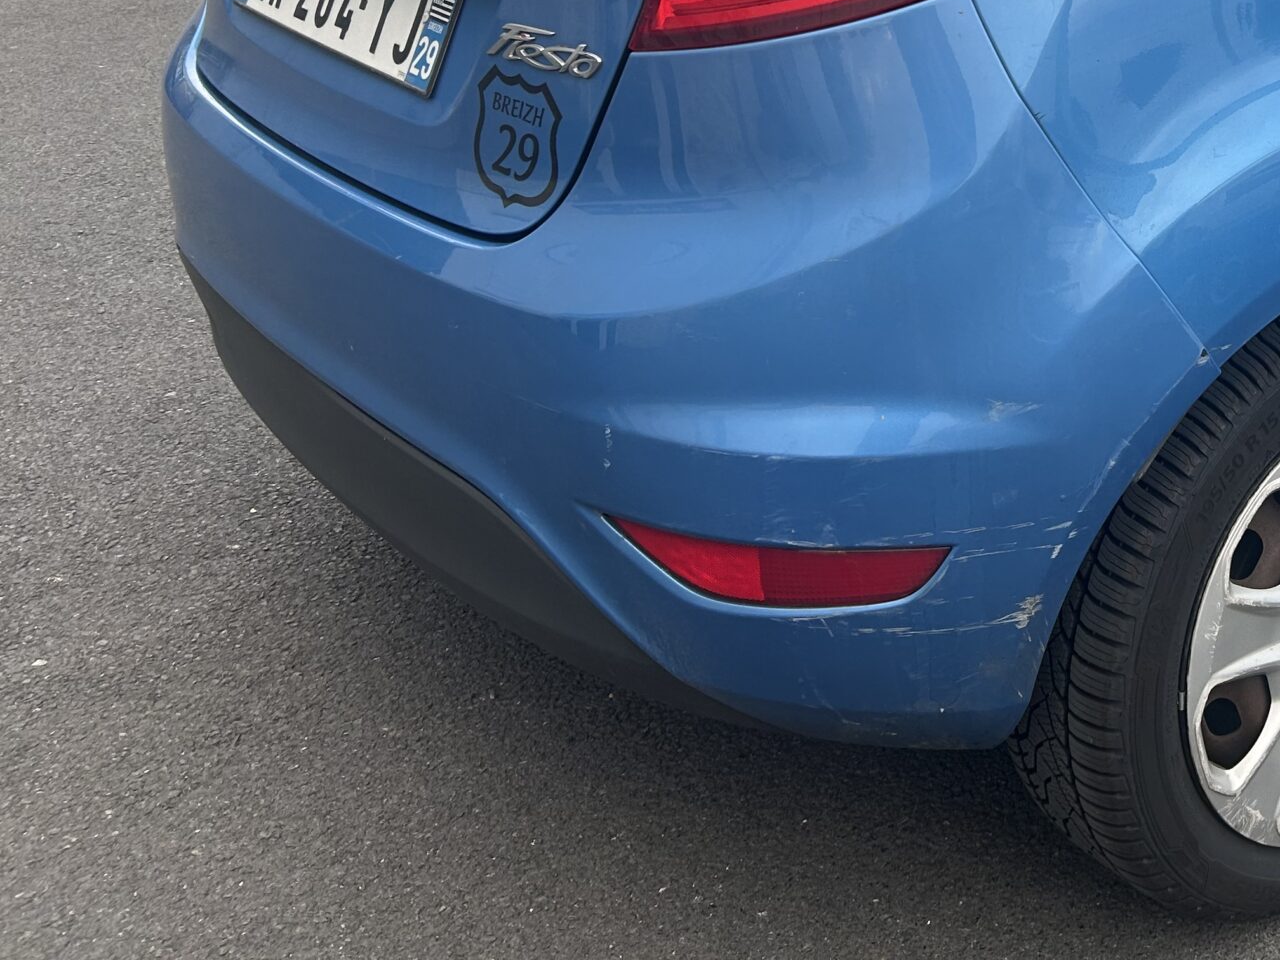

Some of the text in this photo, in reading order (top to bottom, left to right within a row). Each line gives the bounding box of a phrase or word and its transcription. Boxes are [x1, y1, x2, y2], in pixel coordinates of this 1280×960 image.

[409, 35, 440, 81] 29
[486, 22, 603, 80] Fiesta
[492, 91, 545, 128] BREIZH
[491, 123, 540, 182] 29
